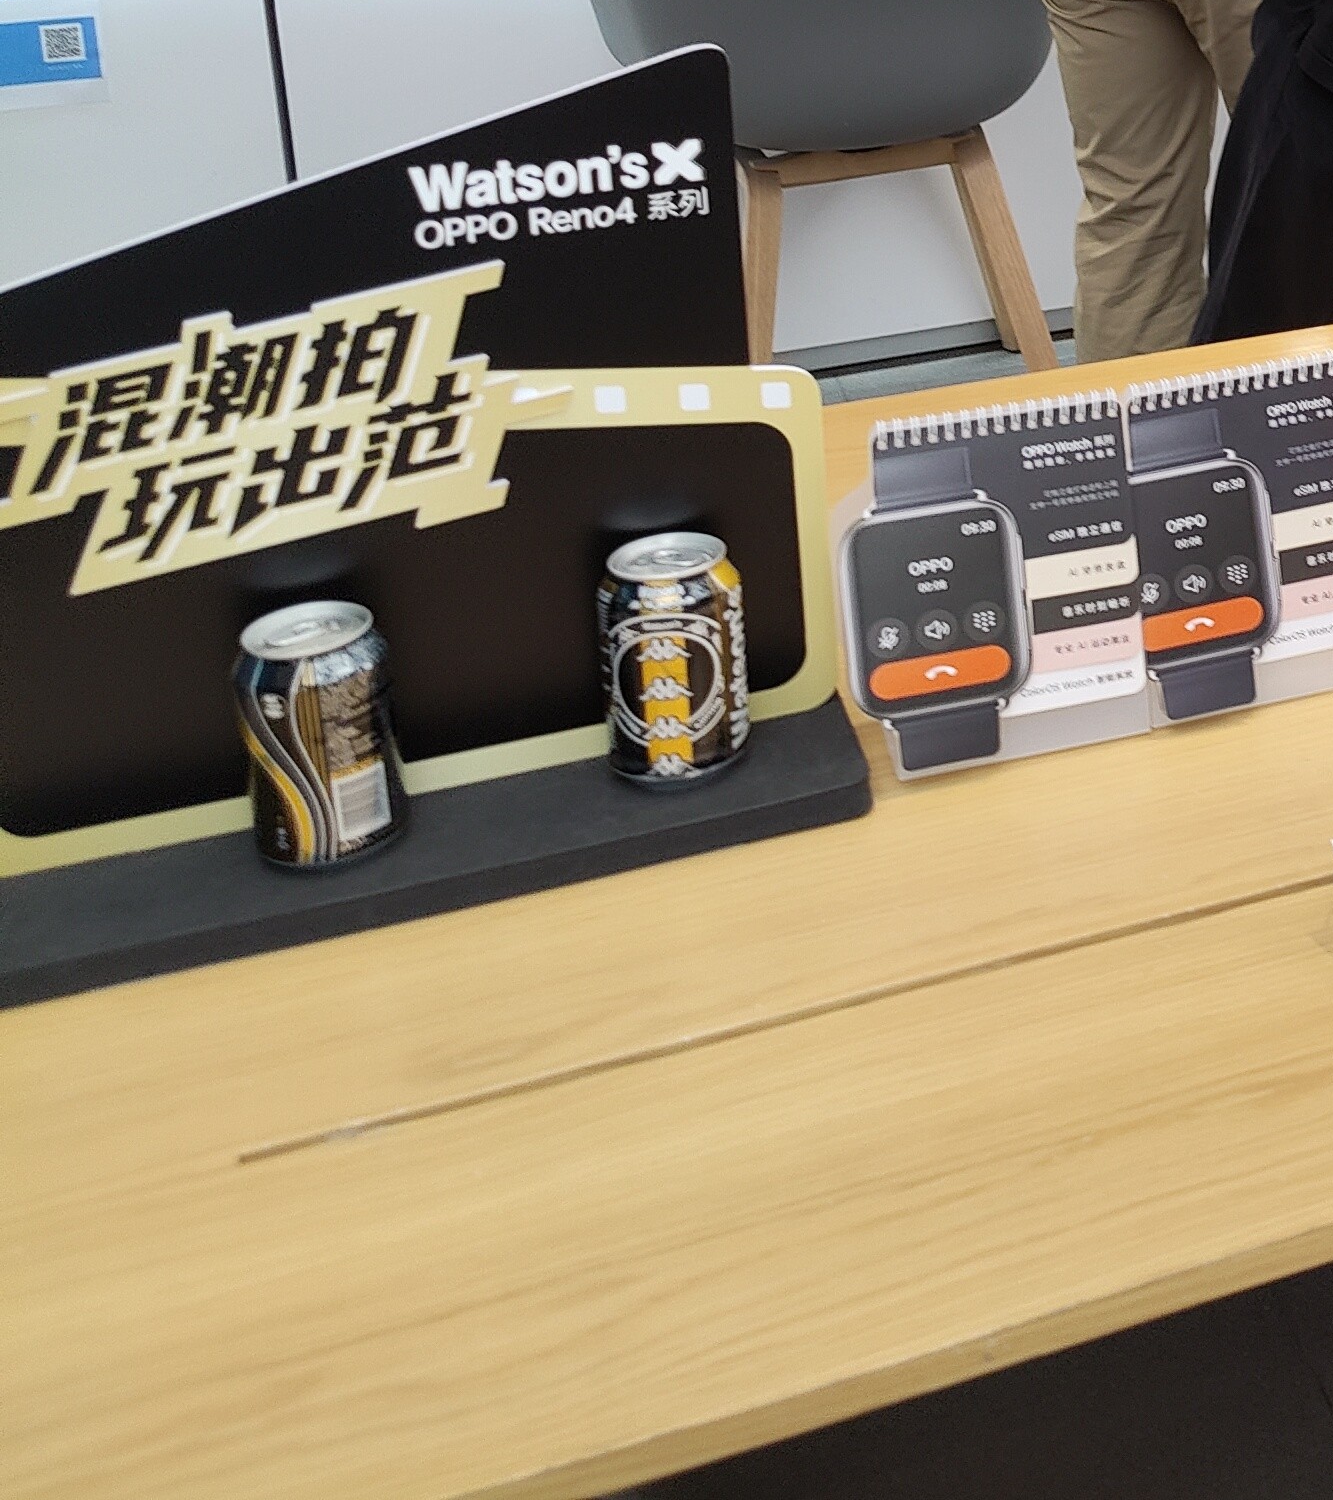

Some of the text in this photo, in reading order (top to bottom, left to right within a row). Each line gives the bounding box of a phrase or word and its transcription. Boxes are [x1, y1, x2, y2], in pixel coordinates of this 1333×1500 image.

[409, 145, 649, 214] Watson's
[414, 187, 711, 251] OPPO Reno4 系列
[0, 308, 416, 500] 混潮拍
[98, 374, 476, 562] 玩出范
[1165, 513, 1208, 534] OPPO
[908, 556, 954, 577] OPPO
